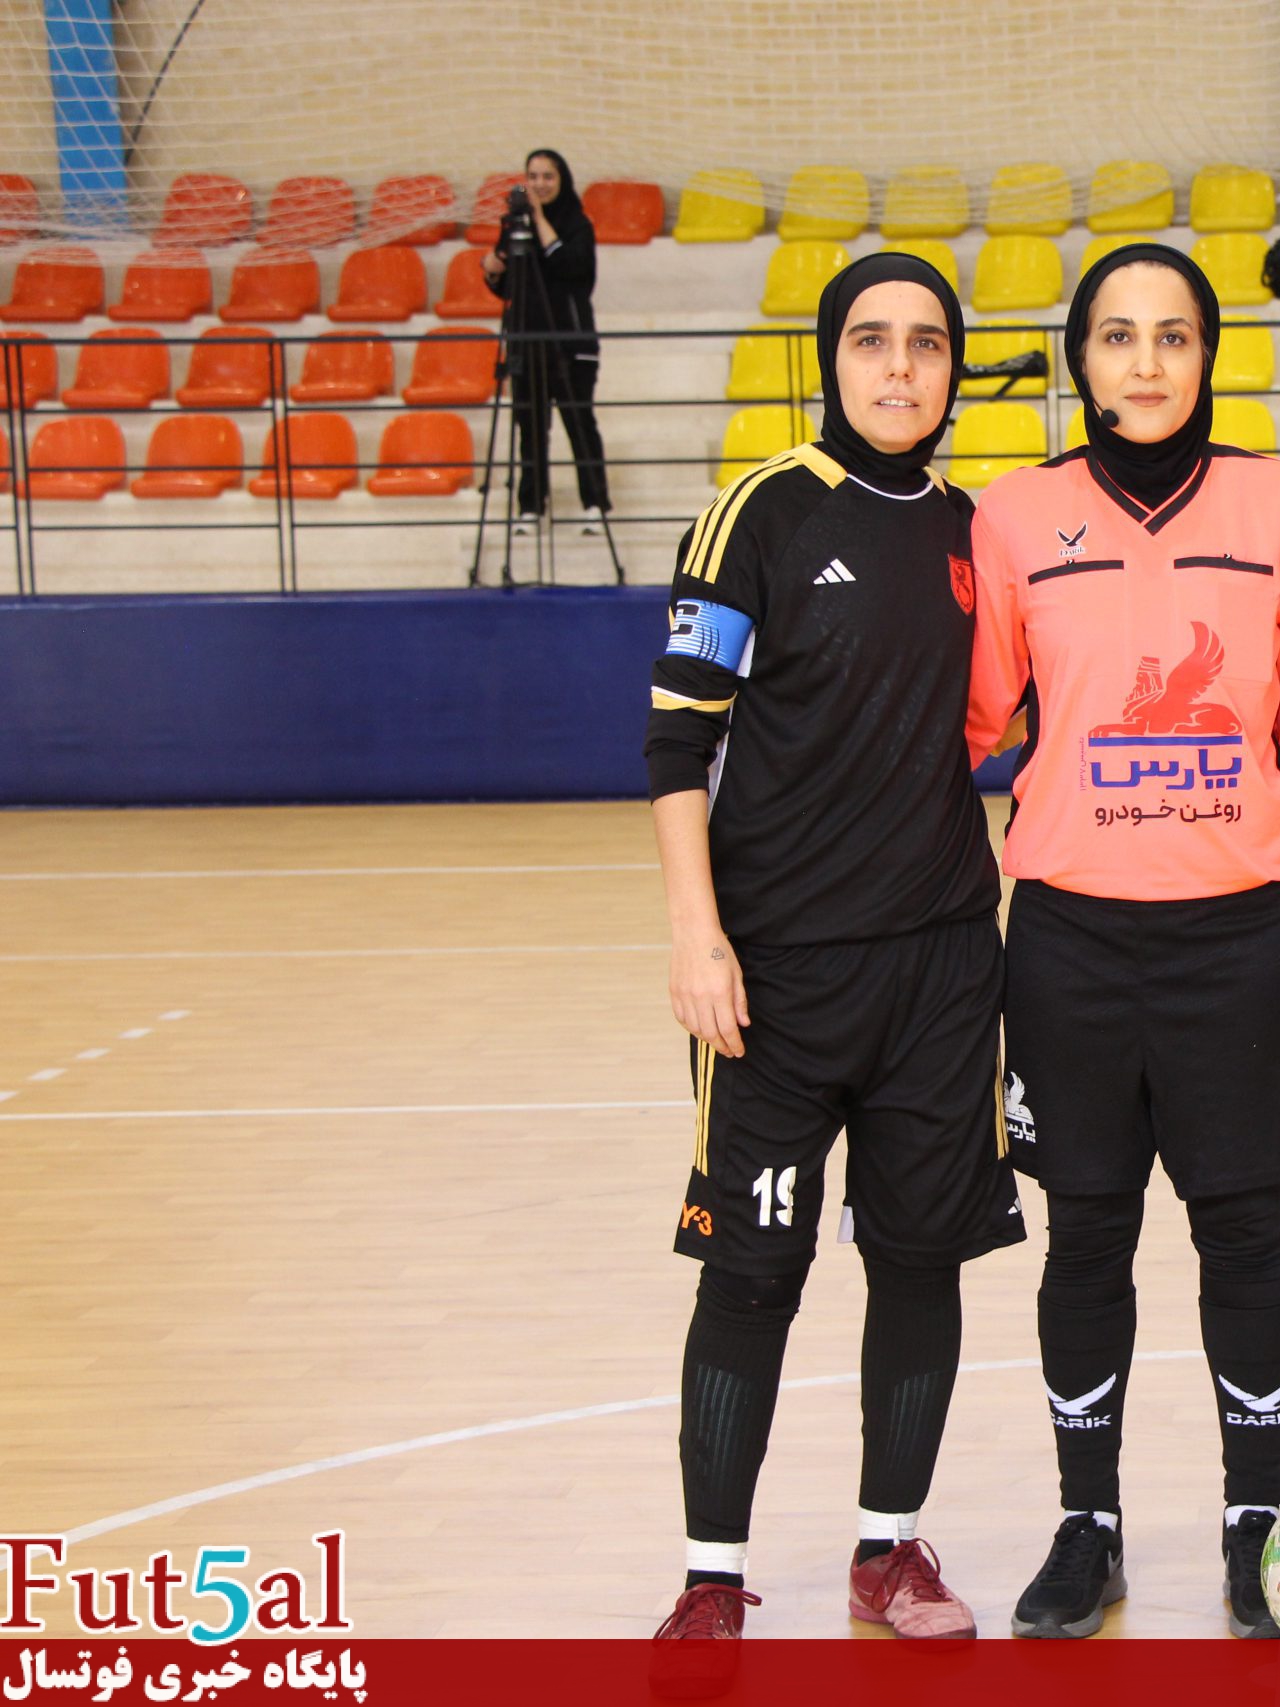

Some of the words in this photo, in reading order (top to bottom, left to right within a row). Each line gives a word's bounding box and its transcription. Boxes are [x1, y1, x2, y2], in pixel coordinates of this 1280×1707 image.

[1090, 748, 1242, 790] پارس
[1094, 798, 1176, 826] خودرو
[1179, 798, 1241, 823] روغن
[753, 1166, 797, 1227] 19
[681, 1200, 713, 1236] Y-3
